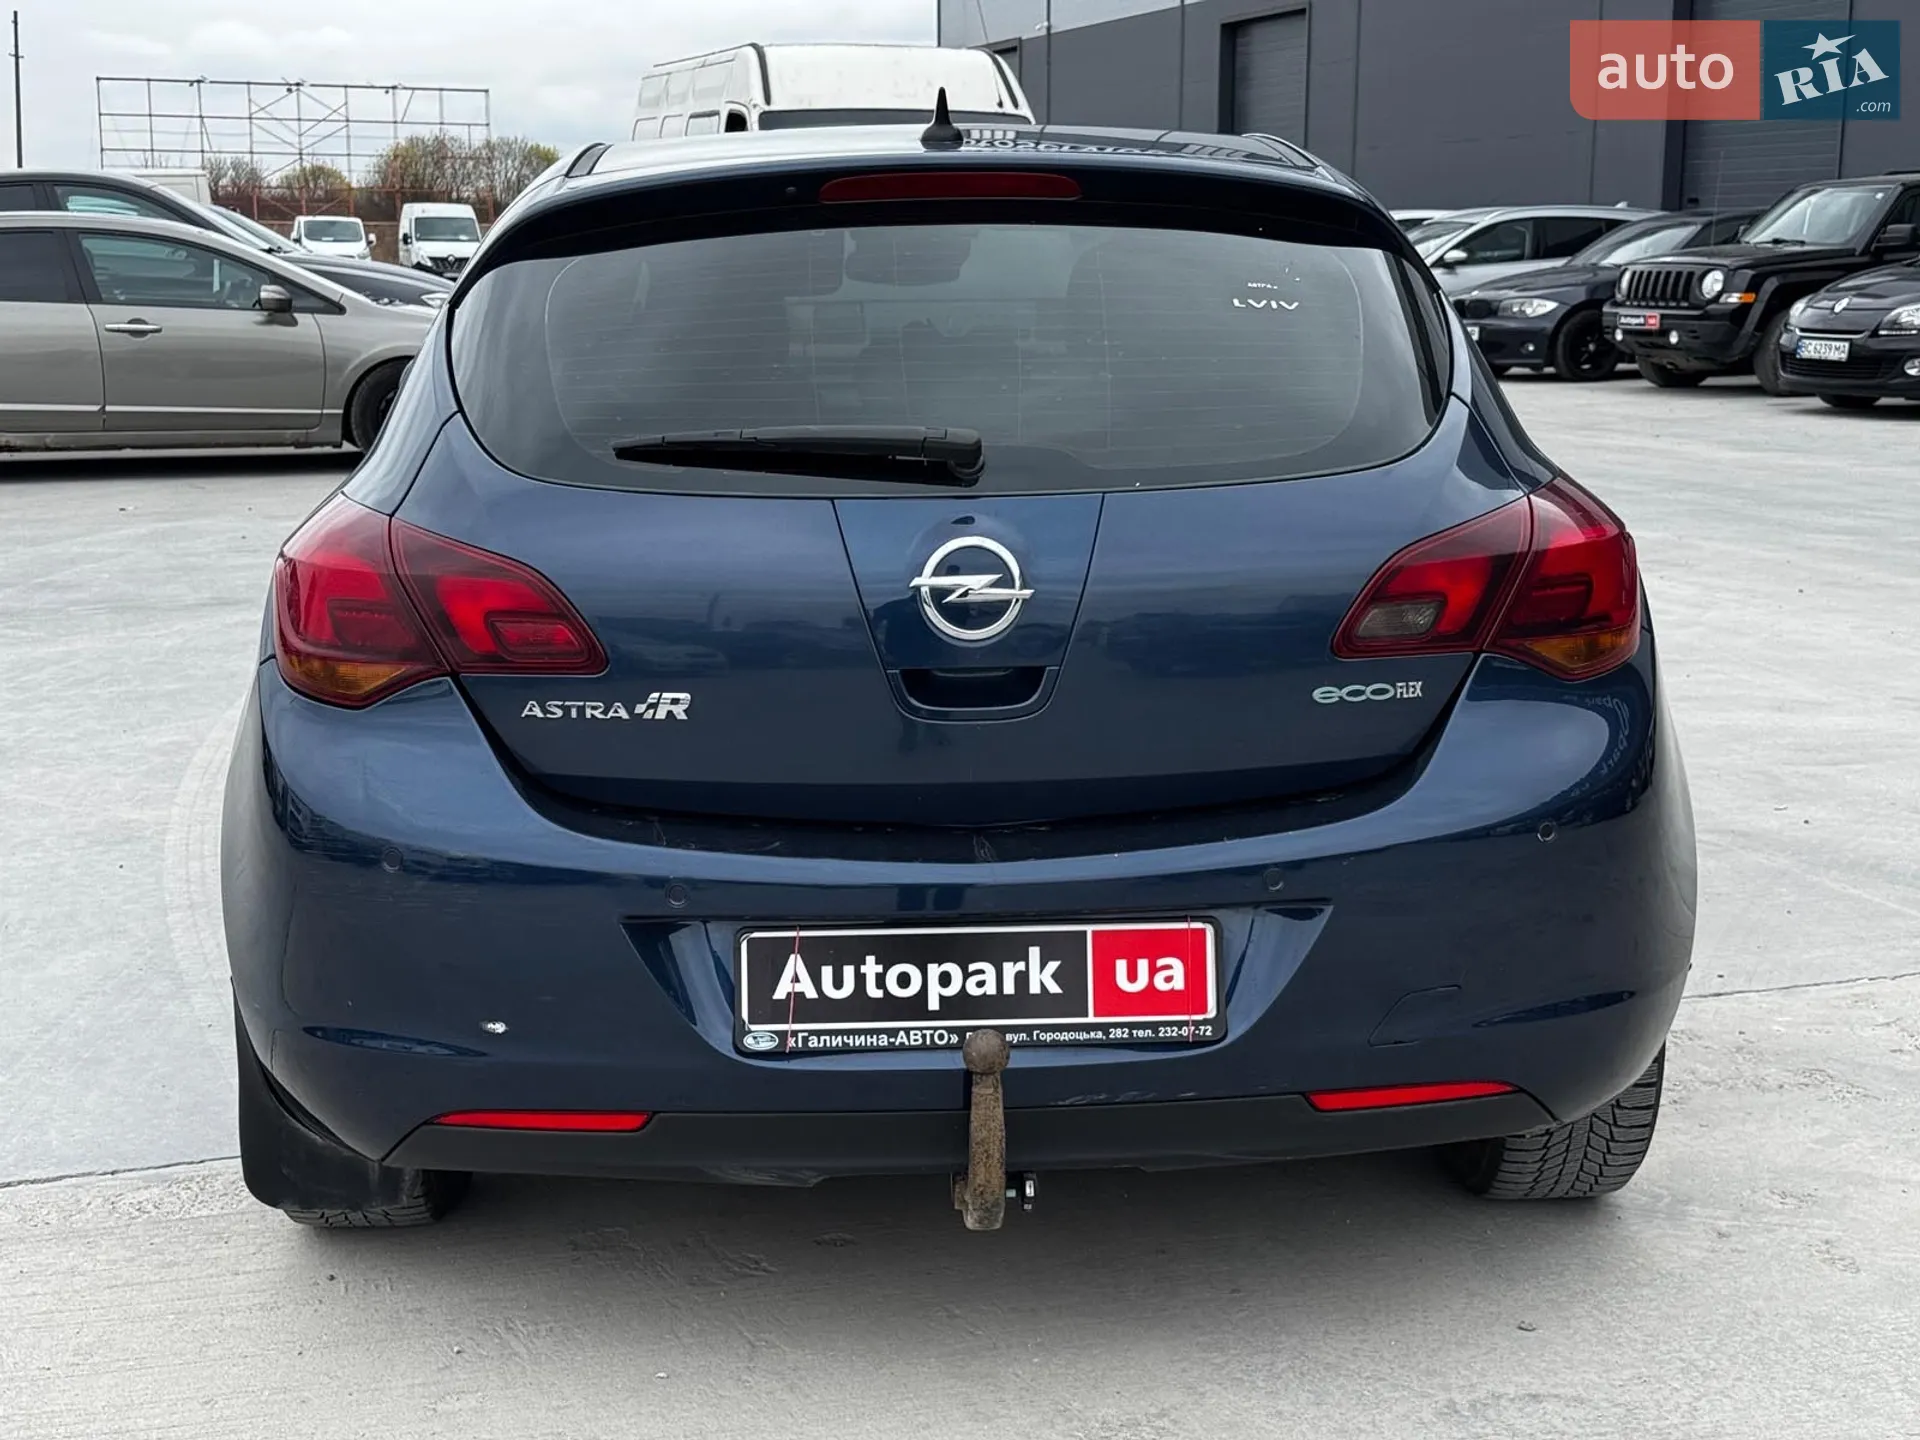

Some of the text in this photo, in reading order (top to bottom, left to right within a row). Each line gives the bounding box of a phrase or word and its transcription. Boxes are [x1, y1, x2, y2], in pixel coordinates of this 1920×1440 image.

[1232, 298, 1299, 310] LVIV
[521, 700, 630, 719] ASTRA
[772, 946, 1185, 1011] Autopark ua
[787, 1029, 959, 1048] «Галичина-АВТО»
[1005, 1031, 1030, 1043] вул.
[1033, 1028, 1106, 1043] Городоцька,
[1109, 1028, 1129, 1038] 282
[1132, 1028, 1154, 1038] тел.
[1158, 1025, 1213, 1037] 232-07-72
